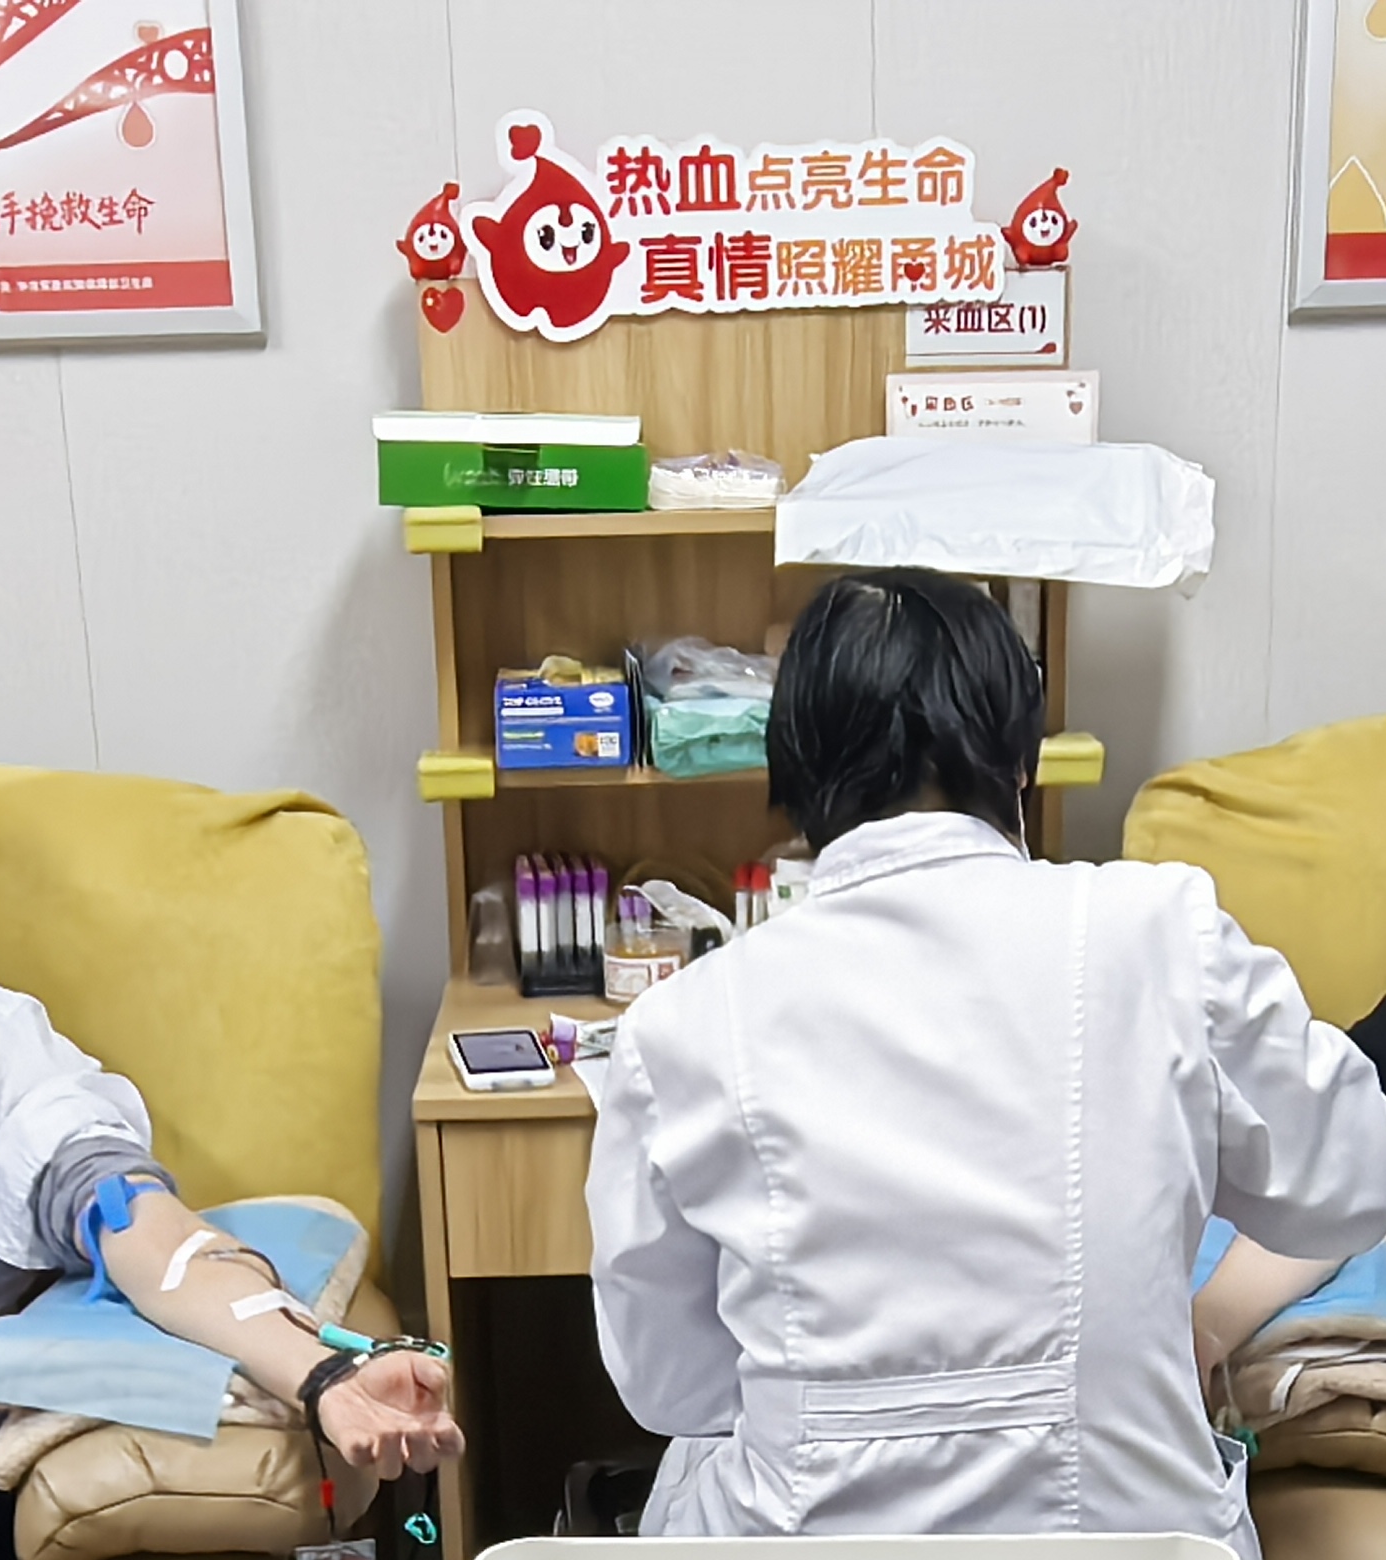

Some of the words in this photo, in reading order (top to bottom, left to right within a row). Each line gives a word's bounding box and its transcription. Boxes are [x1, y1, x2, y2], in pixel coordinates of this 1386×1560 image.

[606, 144, 967, 217] 热血点亮生命
[640, 231, 999, 304] 真情照耀甬城
[924, 302, 1047, 335] 采血区(1)
